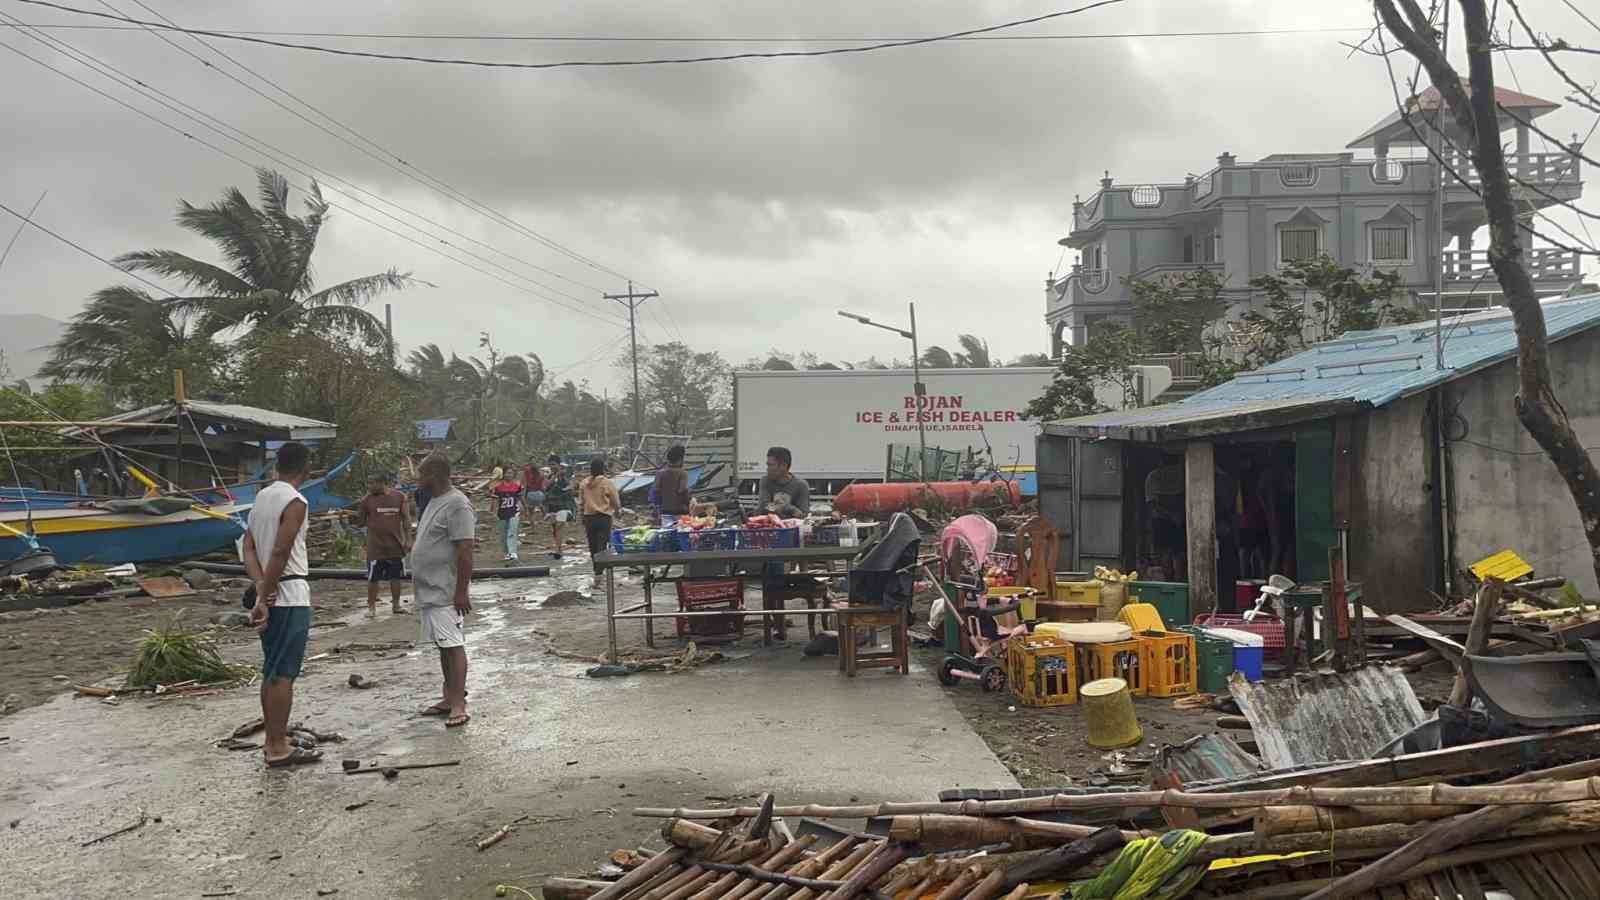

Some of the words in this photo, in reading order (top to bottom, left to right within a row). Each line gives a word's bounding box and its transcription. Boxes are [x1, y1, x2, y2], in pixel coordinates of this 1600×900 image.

[904, 396, 963, 411] ROJAN
[856, 411, 883, 423] ICE
[889, 411, 900, 423] &
[906, 411, 943, 423] FISH
[950, 411, 1015, 423] DEALER
[501, 497, 514, 508] 20
